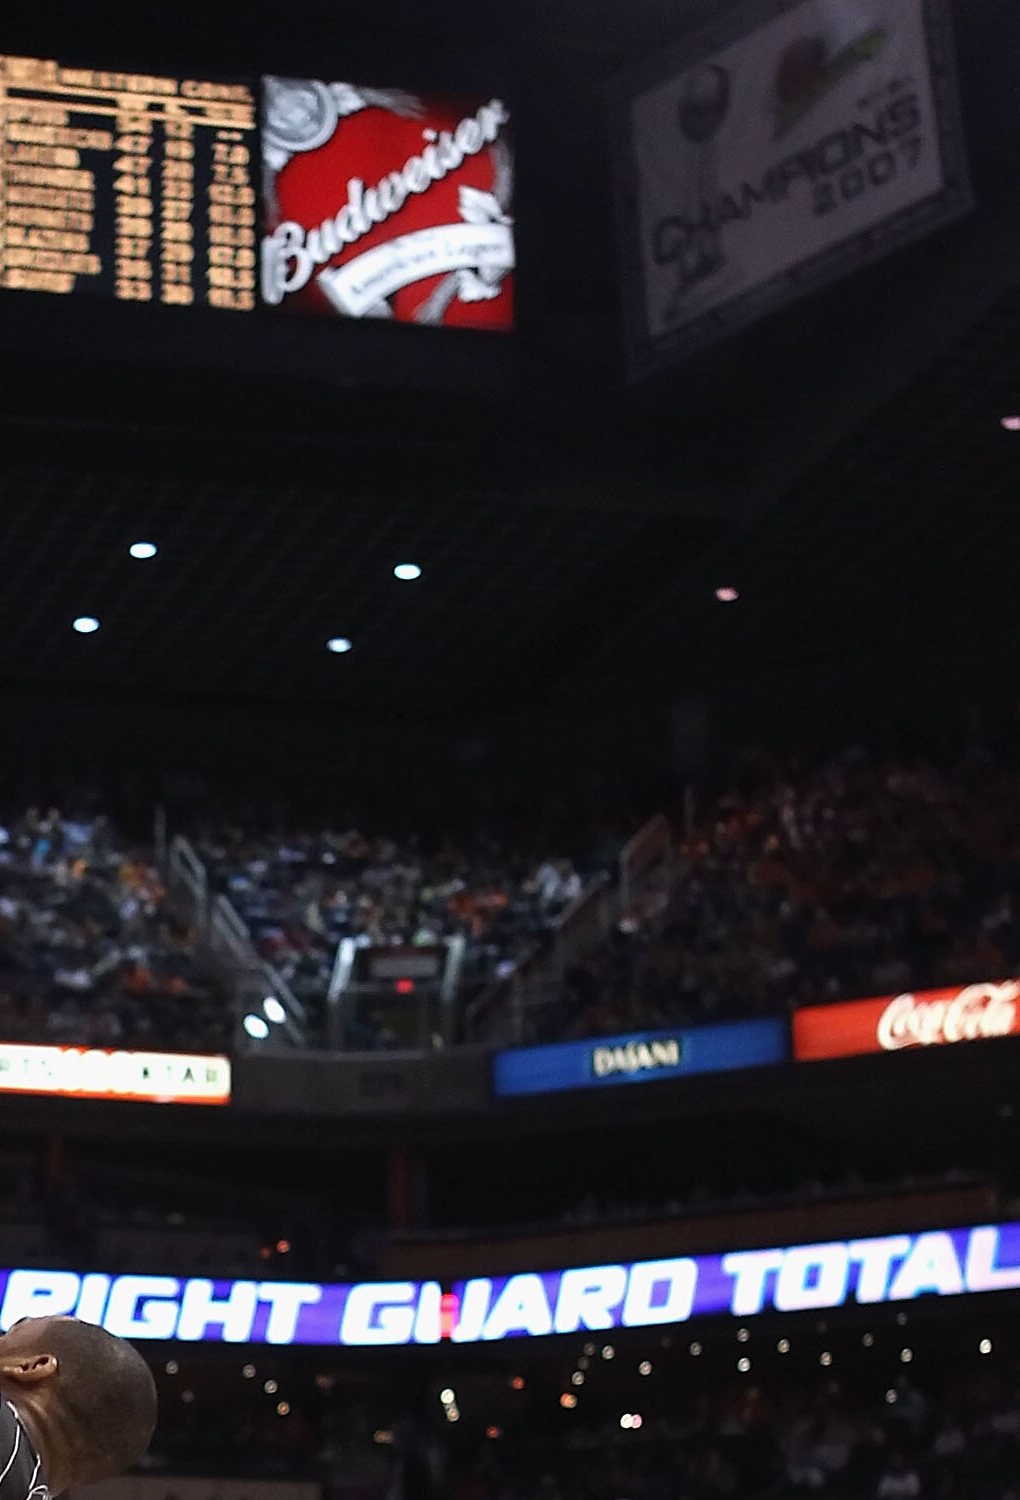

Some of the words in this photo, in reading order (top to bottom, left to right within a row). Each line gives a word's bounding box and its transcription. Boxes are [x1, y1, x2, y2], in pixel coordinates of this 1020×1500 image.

[261, 98, 509, 305] Budweiser
[593, 1040, 678, 1077] DASANI
[339, 1257, 699, 1345] GUARD
[722, 1225, 1020, 1316] TOTAL
